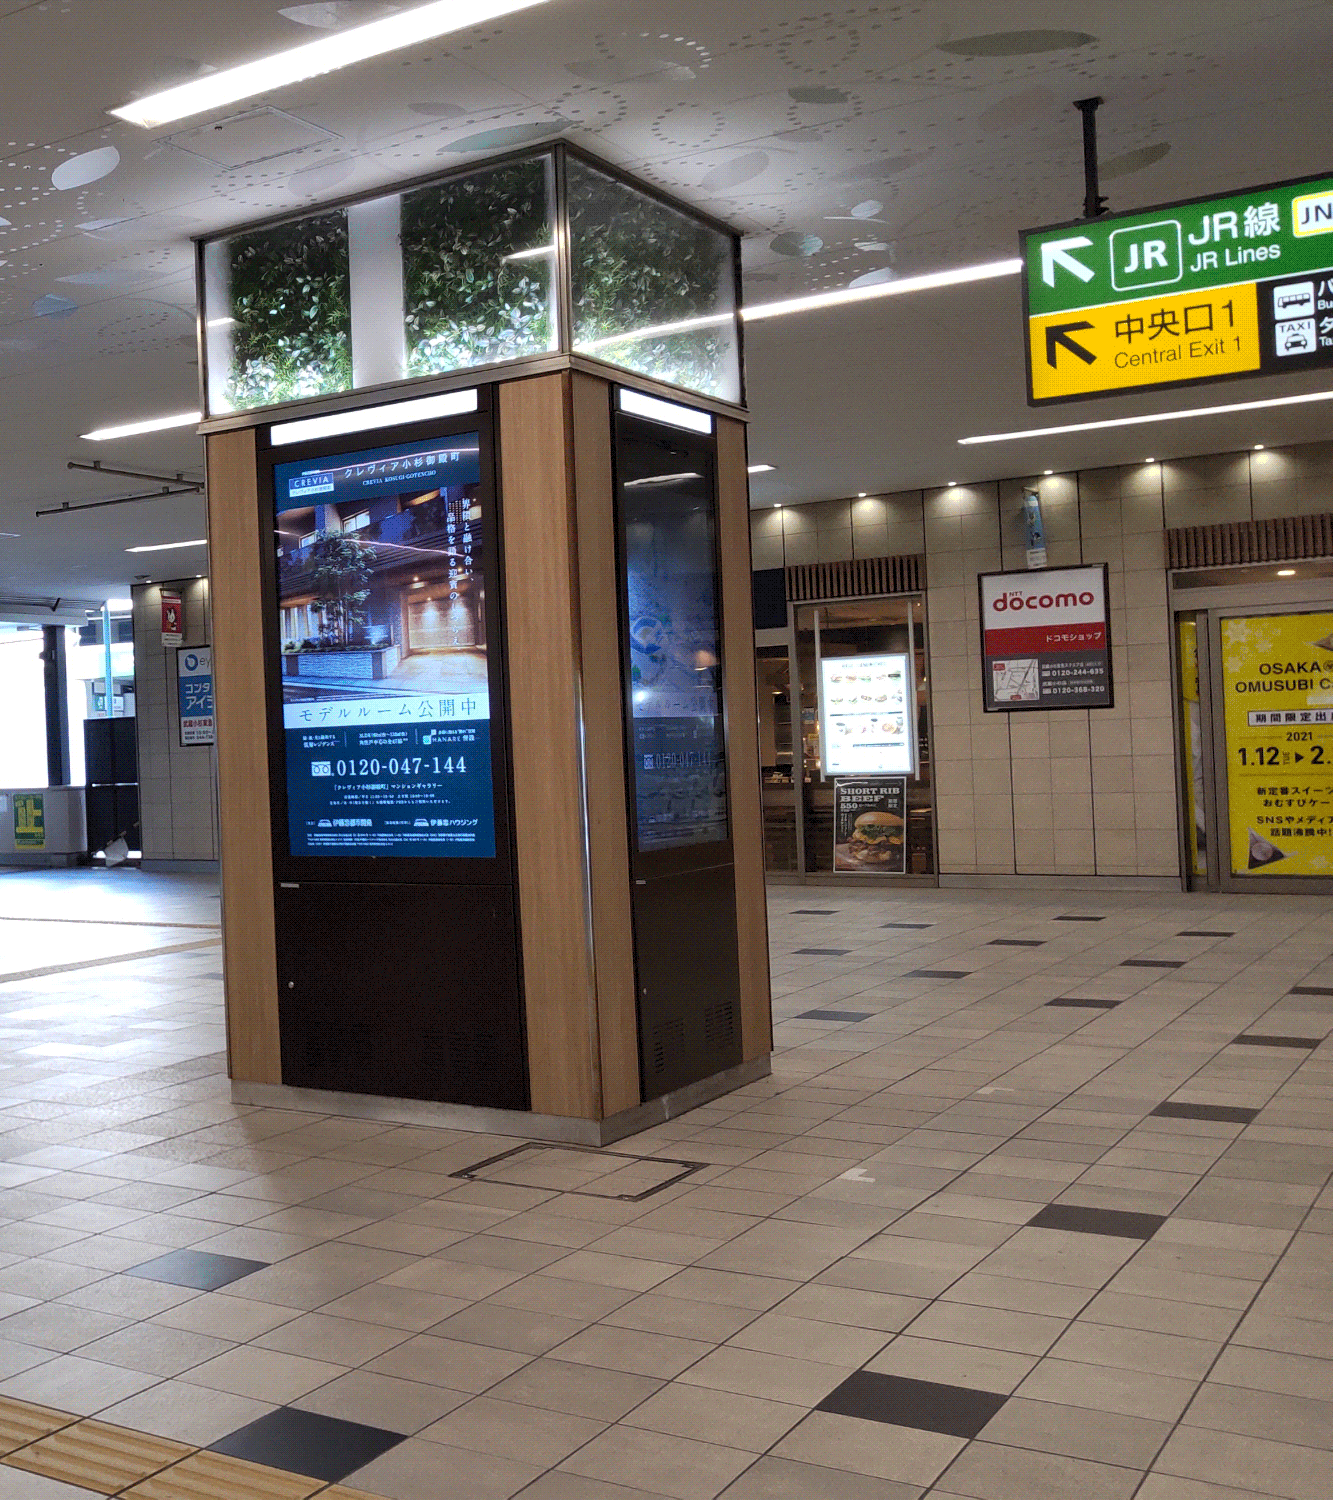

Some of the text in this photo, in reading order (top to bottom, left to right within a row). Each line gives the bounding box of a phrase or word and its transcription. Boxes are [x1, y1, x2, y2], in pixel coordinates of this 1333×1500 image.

[1187, 202, 1281, 246] JR線
[1124, 239, 1168, 273] JR
[1190, 244, 1281, 272] JR Lines
[1114, 299, 1236, 345] 中央口1
[1280, 321, 1311, 334] TAXI
[1114, 335, 1241, 369] Central Exit 1
[294, 476, 329, 488] CREVIA
[992, 591, 1095, 612] docomo
[1046, 631, 1102, 643] ドコモショップ
[1259, 661, 1321, 675] OSAKA
[1235, 679, 1313, 693] OMUSUBI
[299, 697, 477, 722] モデルルーム公開中
[1255, 711, 1333, 723] 期間限定出
[1286, 731, 1313, 742] 2021
[1238, 746, 1279, 766] 1.12
[336, 756, 467, 776] 0120-047-144
[840, 787, 900, 795] SHORT RIB
[840, 795, 884, 803] BEEF
